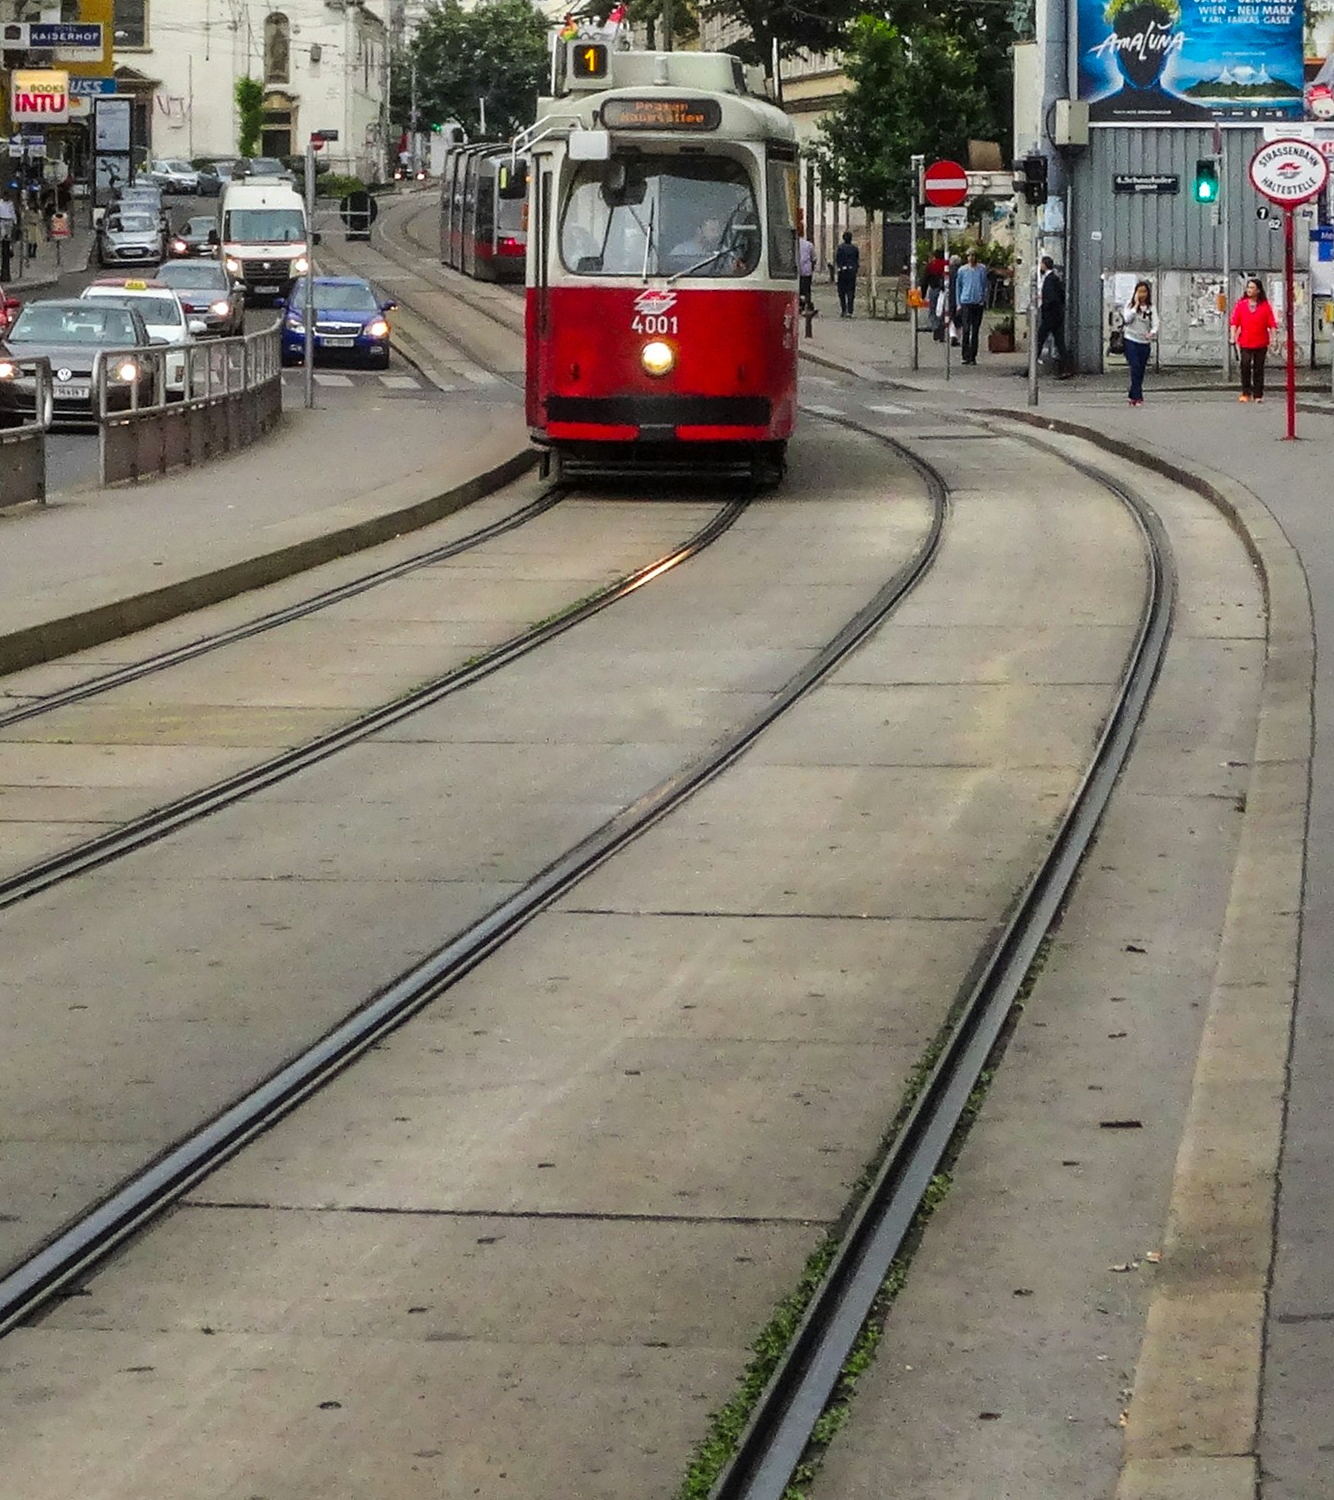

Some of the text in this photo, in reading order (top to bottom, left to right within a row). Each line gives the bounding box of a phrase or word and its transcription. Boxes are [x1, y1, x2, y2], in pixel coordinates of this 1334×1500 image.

[1199, 5, 1226, 16] WIEN
[1238, 5, 1259, 16] NEU
[1262, 5, 1294, 16] MARX
[1310, 1, 1334, 11] sich
[31, 32, 99, 41] KAISERHOF
[584, 49, 596, 71] 1
[30, 84, 65, 93] BOOKS
[14, 94, 65, 113] INTU
[1259, 146, 1319, 167] STRASSENBAHN
[1261, 177, 1317, 195] HALTESTELLE
[1259, 209, 1266, 218] 1
[1268, 219, 1280, 229] 62
[631, 315, 678, 334] 4001
